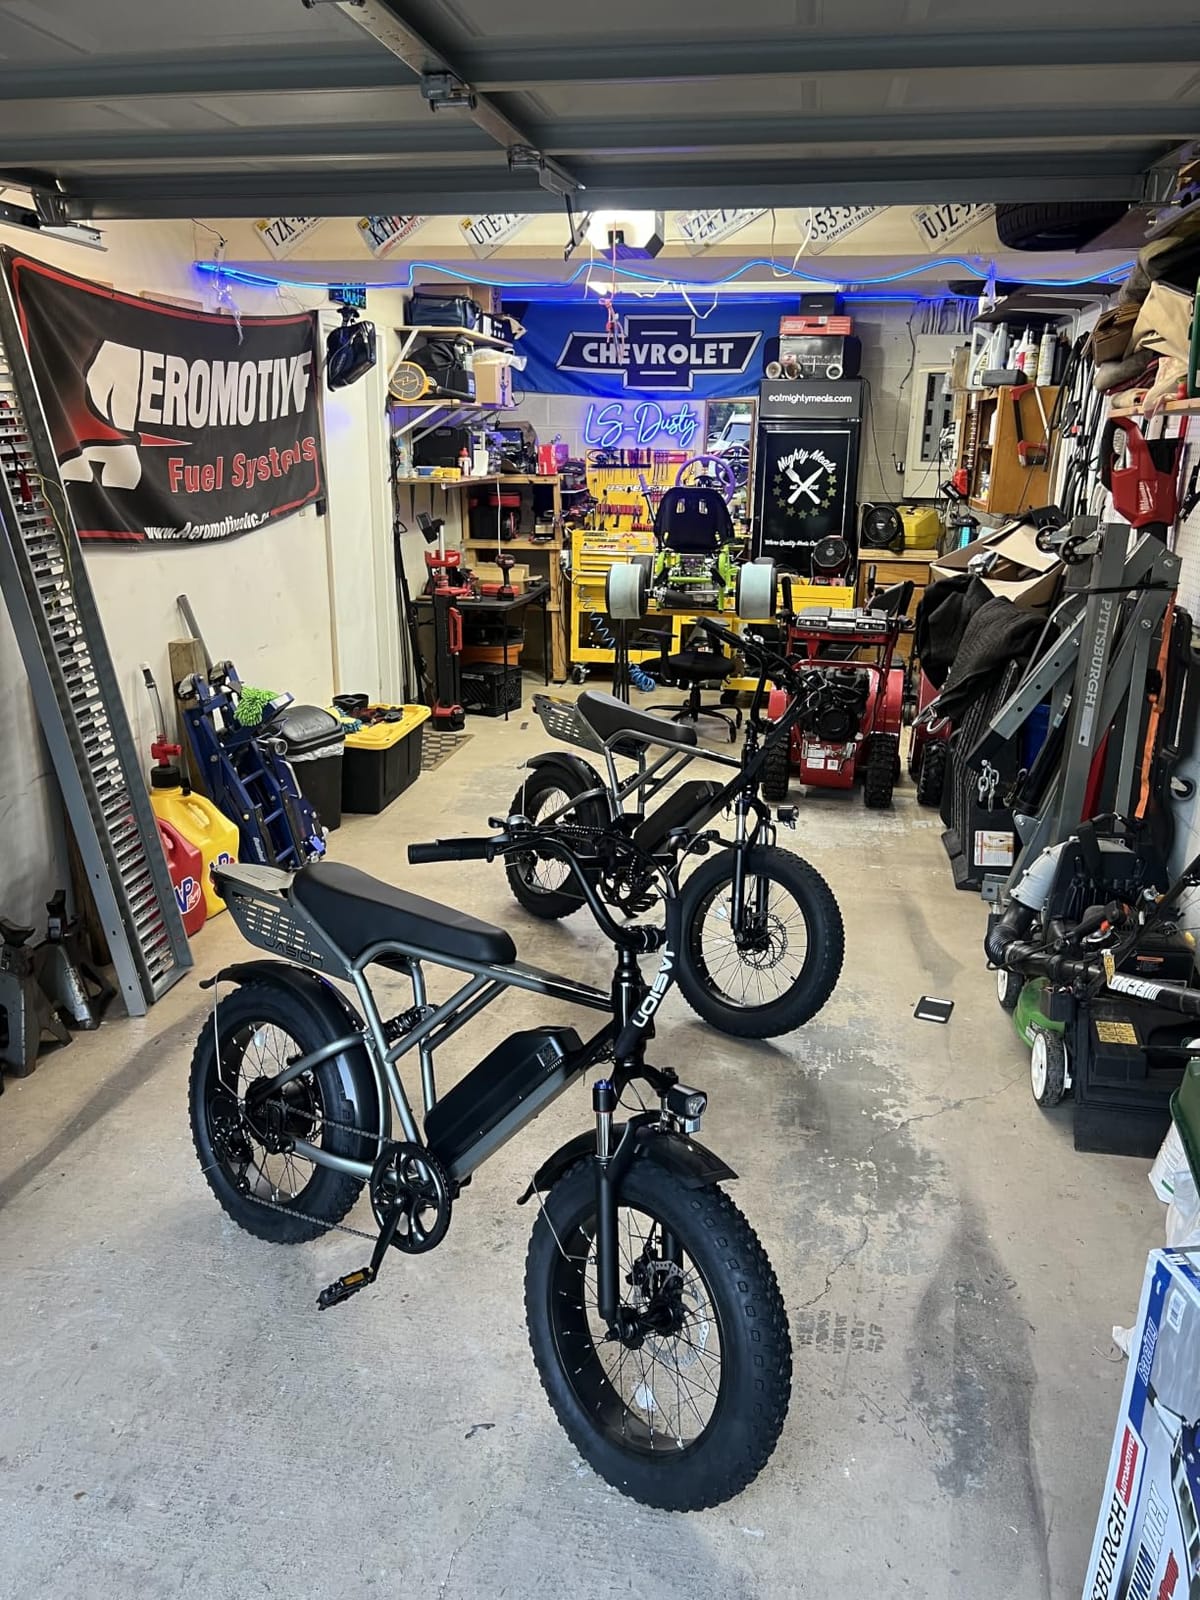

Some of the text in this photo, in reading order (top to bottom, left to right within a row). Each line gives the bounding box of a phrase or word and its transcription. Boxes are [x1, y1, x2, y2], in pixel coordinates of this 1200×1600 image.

[826, 218, 854, 240] PERMANENT
[582, 342, 735, 365] CHEVROLET
[768, 393, 853, 404] eatmightymeals.com
[585, 401, 698, 448] LS-Dusty
[168, 456, 224, 493] Fuel
[777, 448, 837, 474] Mighty Meals
[1085, 599, 1112, 708] PITTSBURGH
[173, 876, 194, 914] VP
[1137, 1316, 1159, 1387] Racing
[1119, 1434, 1136, 1500] AUTOMOTIVE
[1141, 1479, 1170, 1563] JACK
[1091, 1491, 1127, 1600] SBURGH
